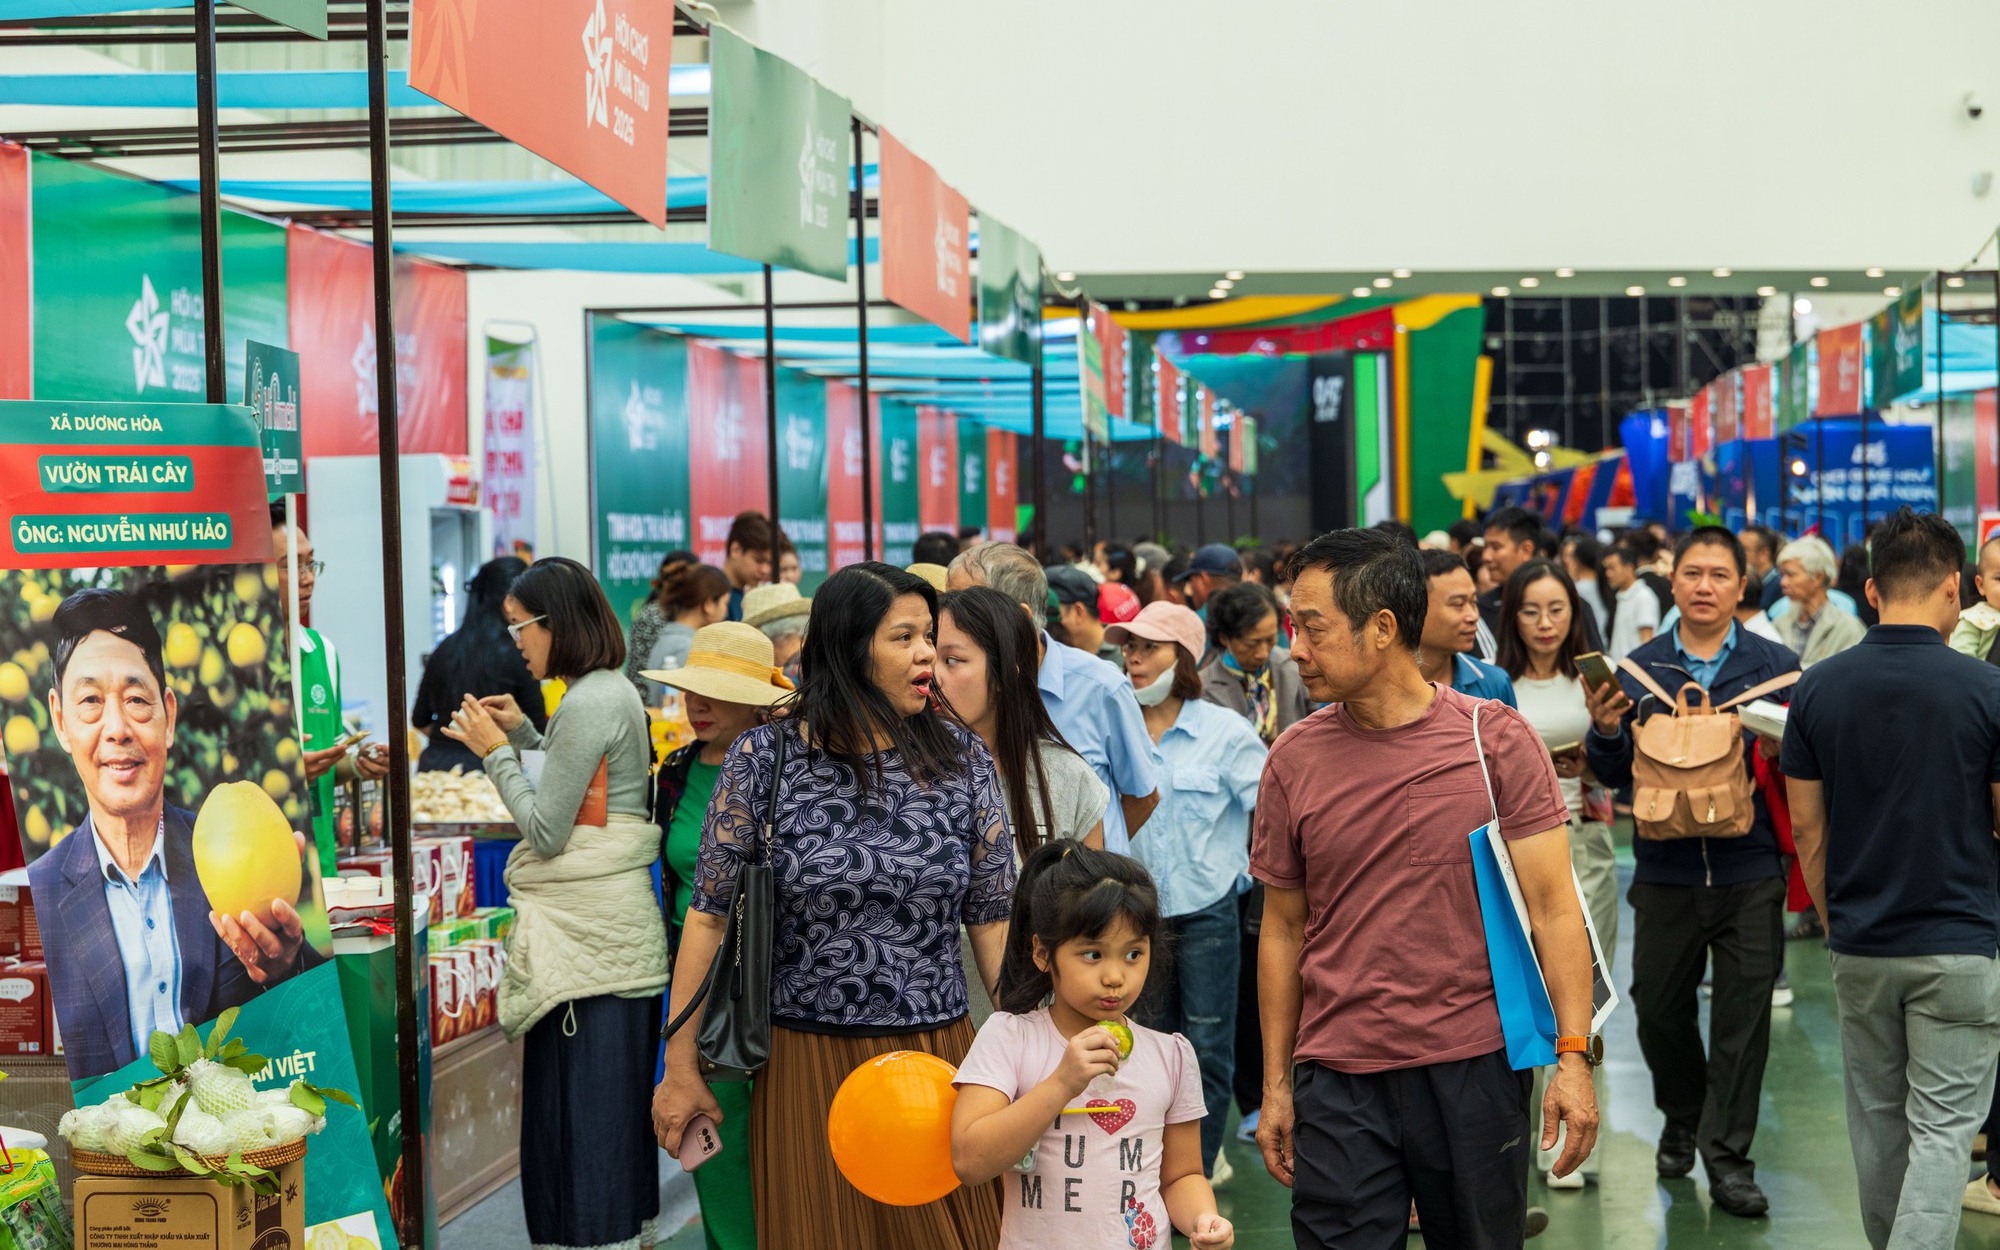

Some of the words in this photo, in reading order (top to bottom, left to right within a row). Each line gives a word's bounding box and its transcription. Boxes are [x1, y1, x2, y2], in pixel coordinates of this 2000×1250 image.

[612, 105, 635, 146] 2025
[50, 412, 72, 431] XÃ
[75, 414, 128, 432] DƯƠNG
[131, 414, 163, 432] HÒA
[45, 460, 102, 484] VƯỜN
[105, 461, 148, 483] TRÁI
[152, 460, 188, 483] CÂY
[18, 520, 64, 544] ÔNG:
[67, 516, 145, 543] NGUYỄN
[149, 520, 189, 541] NHƯ
[192, 517, 227, 541] HẢO
[275, 1048, 317, 1080] VIỆT
